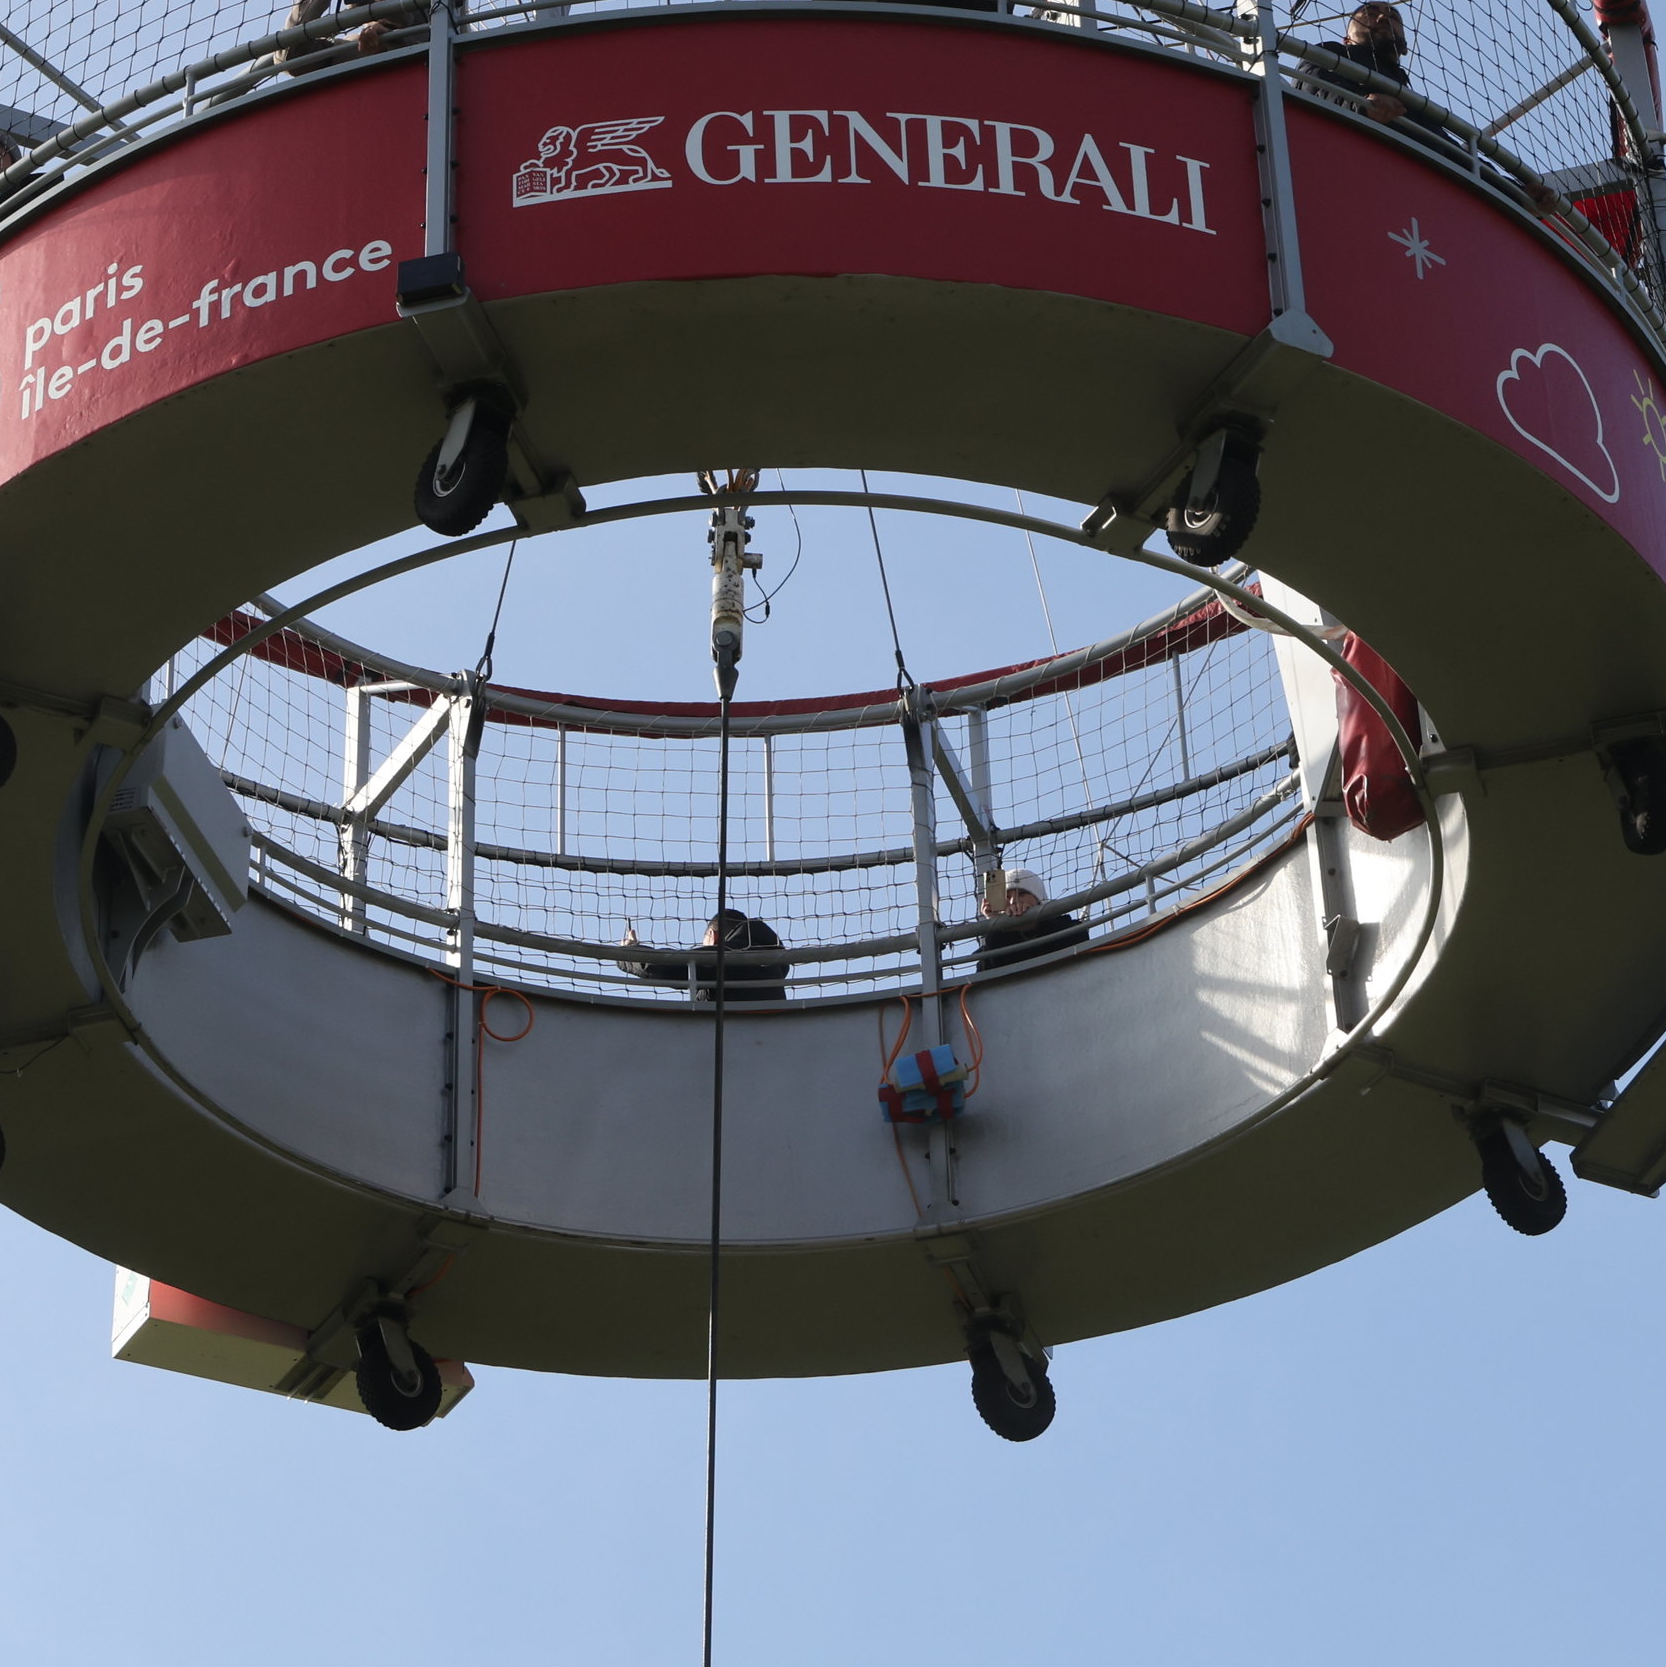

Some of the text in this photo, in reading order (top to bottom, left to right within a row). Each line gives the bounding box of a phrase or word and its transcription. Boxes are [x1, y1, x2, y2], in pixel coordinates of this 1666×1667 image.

[685, 109, 1217, 235] GENERALI
[19, 238, 393, 421] île-de-france
[24, 262, 144, 369] paris
